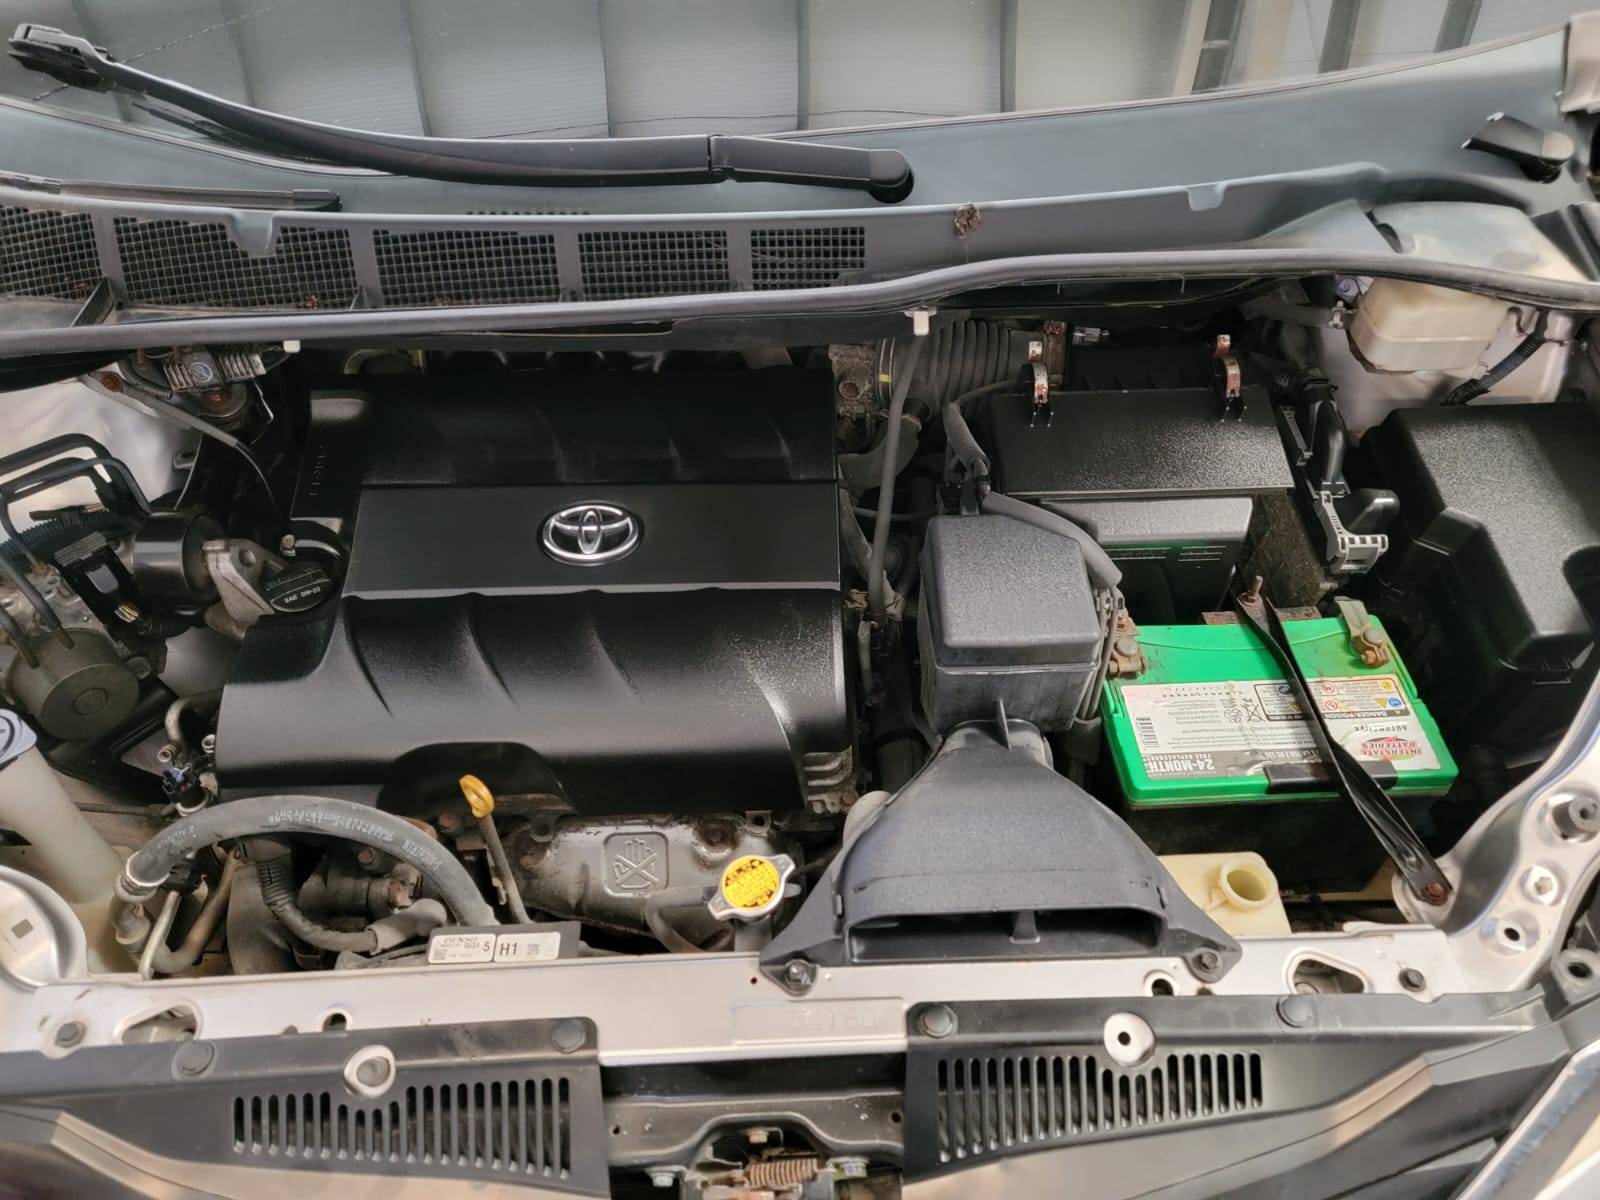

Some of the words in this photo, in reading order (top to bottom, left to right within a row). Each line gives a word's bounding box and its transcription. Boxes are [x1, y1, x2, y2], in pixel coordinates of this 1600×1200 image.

[1324, 710, 1388, 719] DANGER/POISON
[1361, 740, 1416, 749] BATTERIES
[1361, 746, 1422, 756] INTERSTATE
[1147, 758, 1216, 773] 24-MONTH
[483, 941, 491, 952] 5
[499, 942, 518, 956] H1
